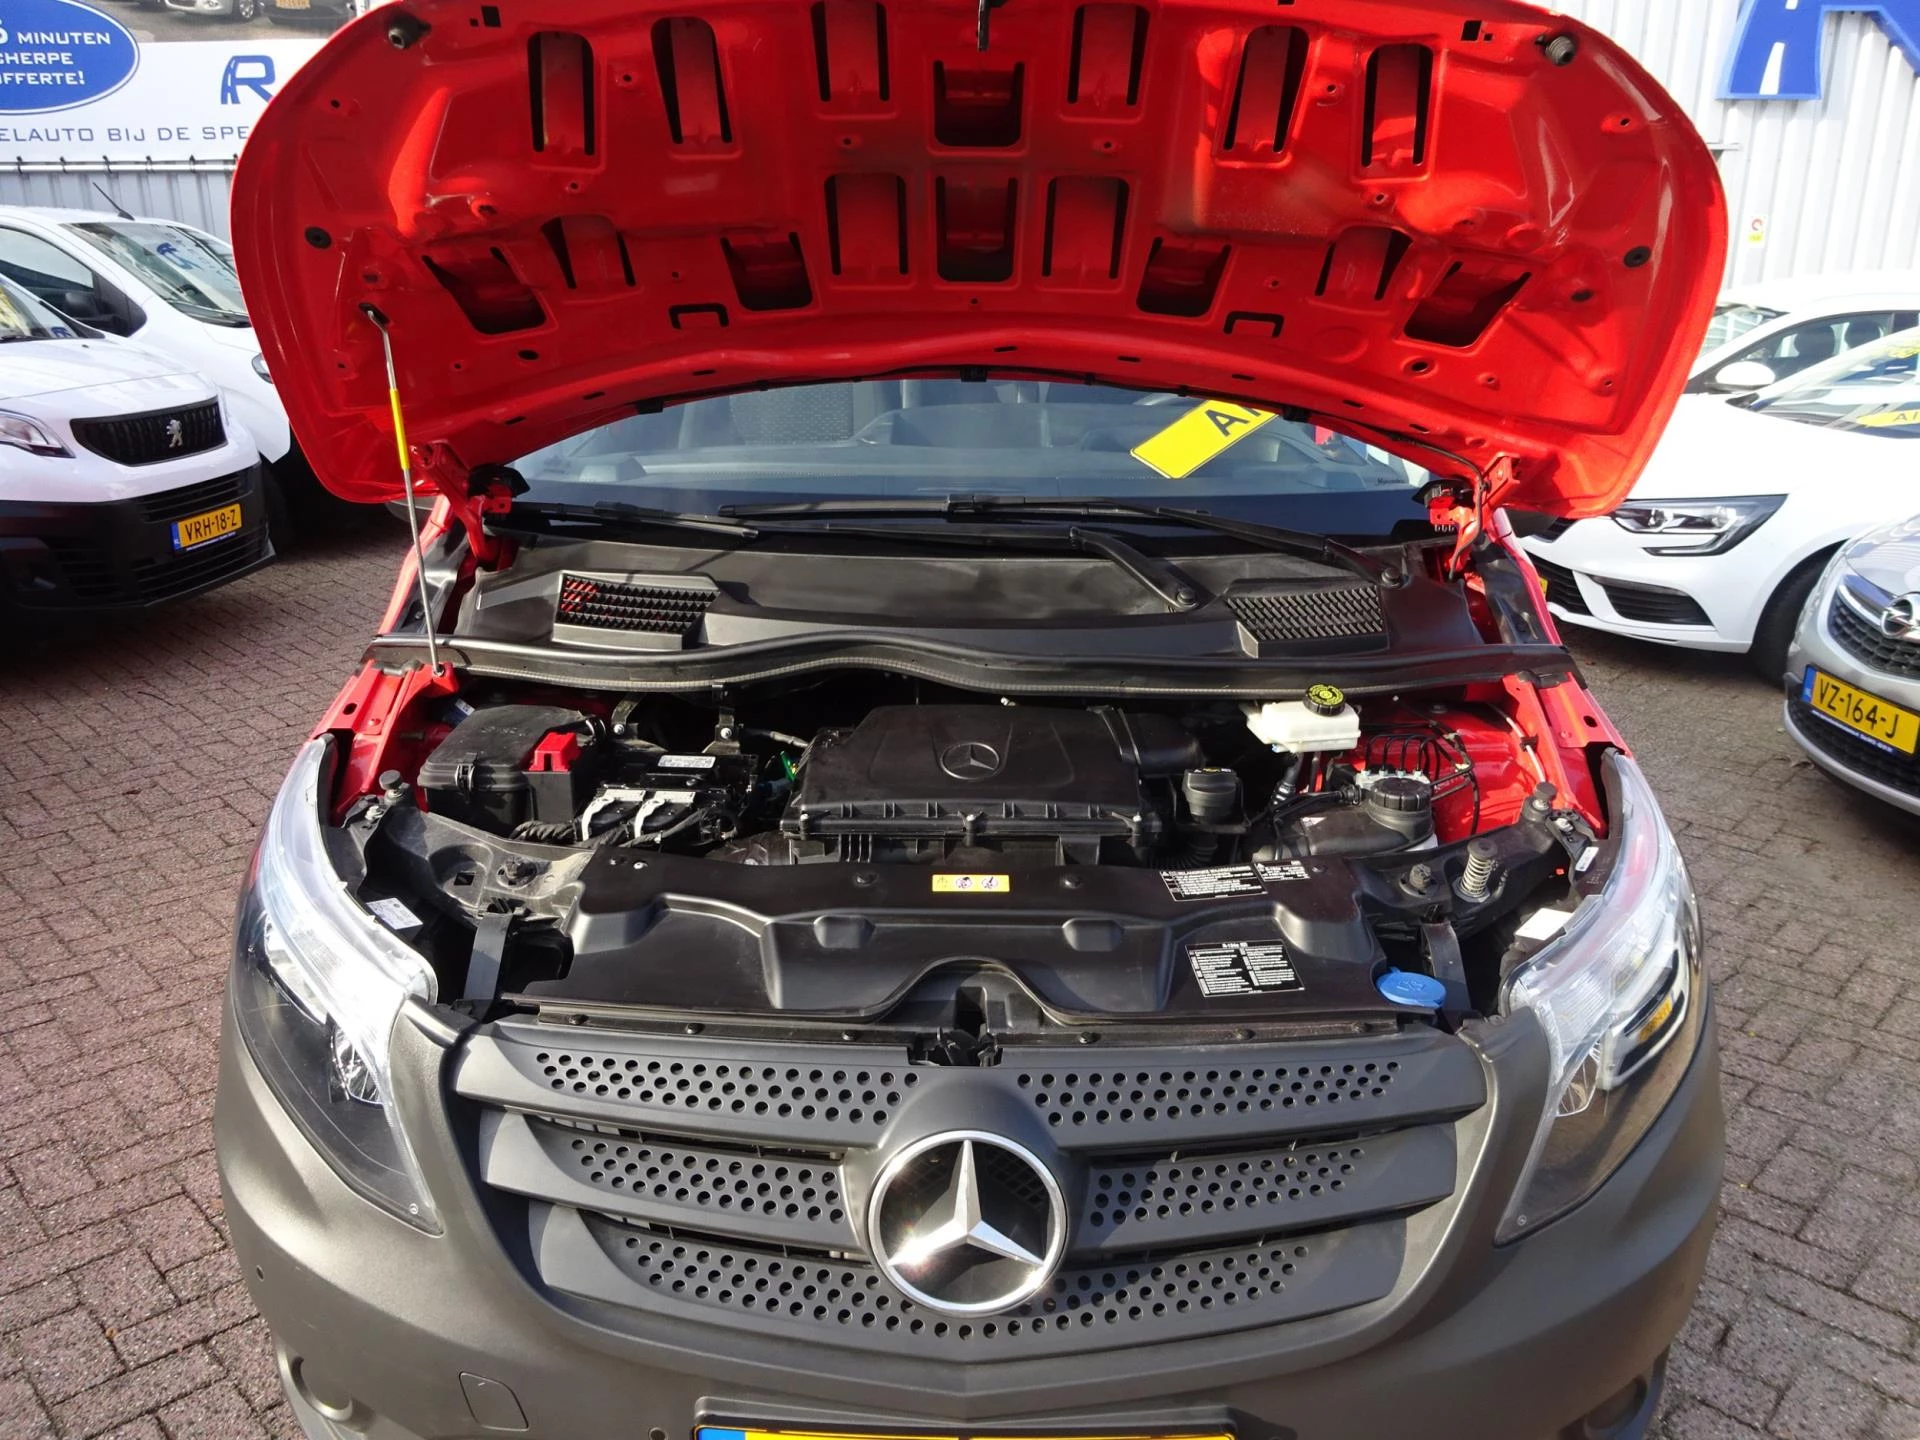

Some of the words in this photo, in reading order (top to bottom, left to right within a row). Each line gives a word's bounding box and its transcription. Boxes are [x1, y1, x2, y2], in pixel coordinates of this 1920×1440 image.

[17, 31, 111, 45] MINUTEN
[0, 70, 85, 85] FFERTE!
[108, 127, 146, 142] BIJ
[158, 127, 191, 141] DE
[185, 509, 237, 541] VRH-18-Z
[1819, 678, 1899, 739] VZ-164-J
